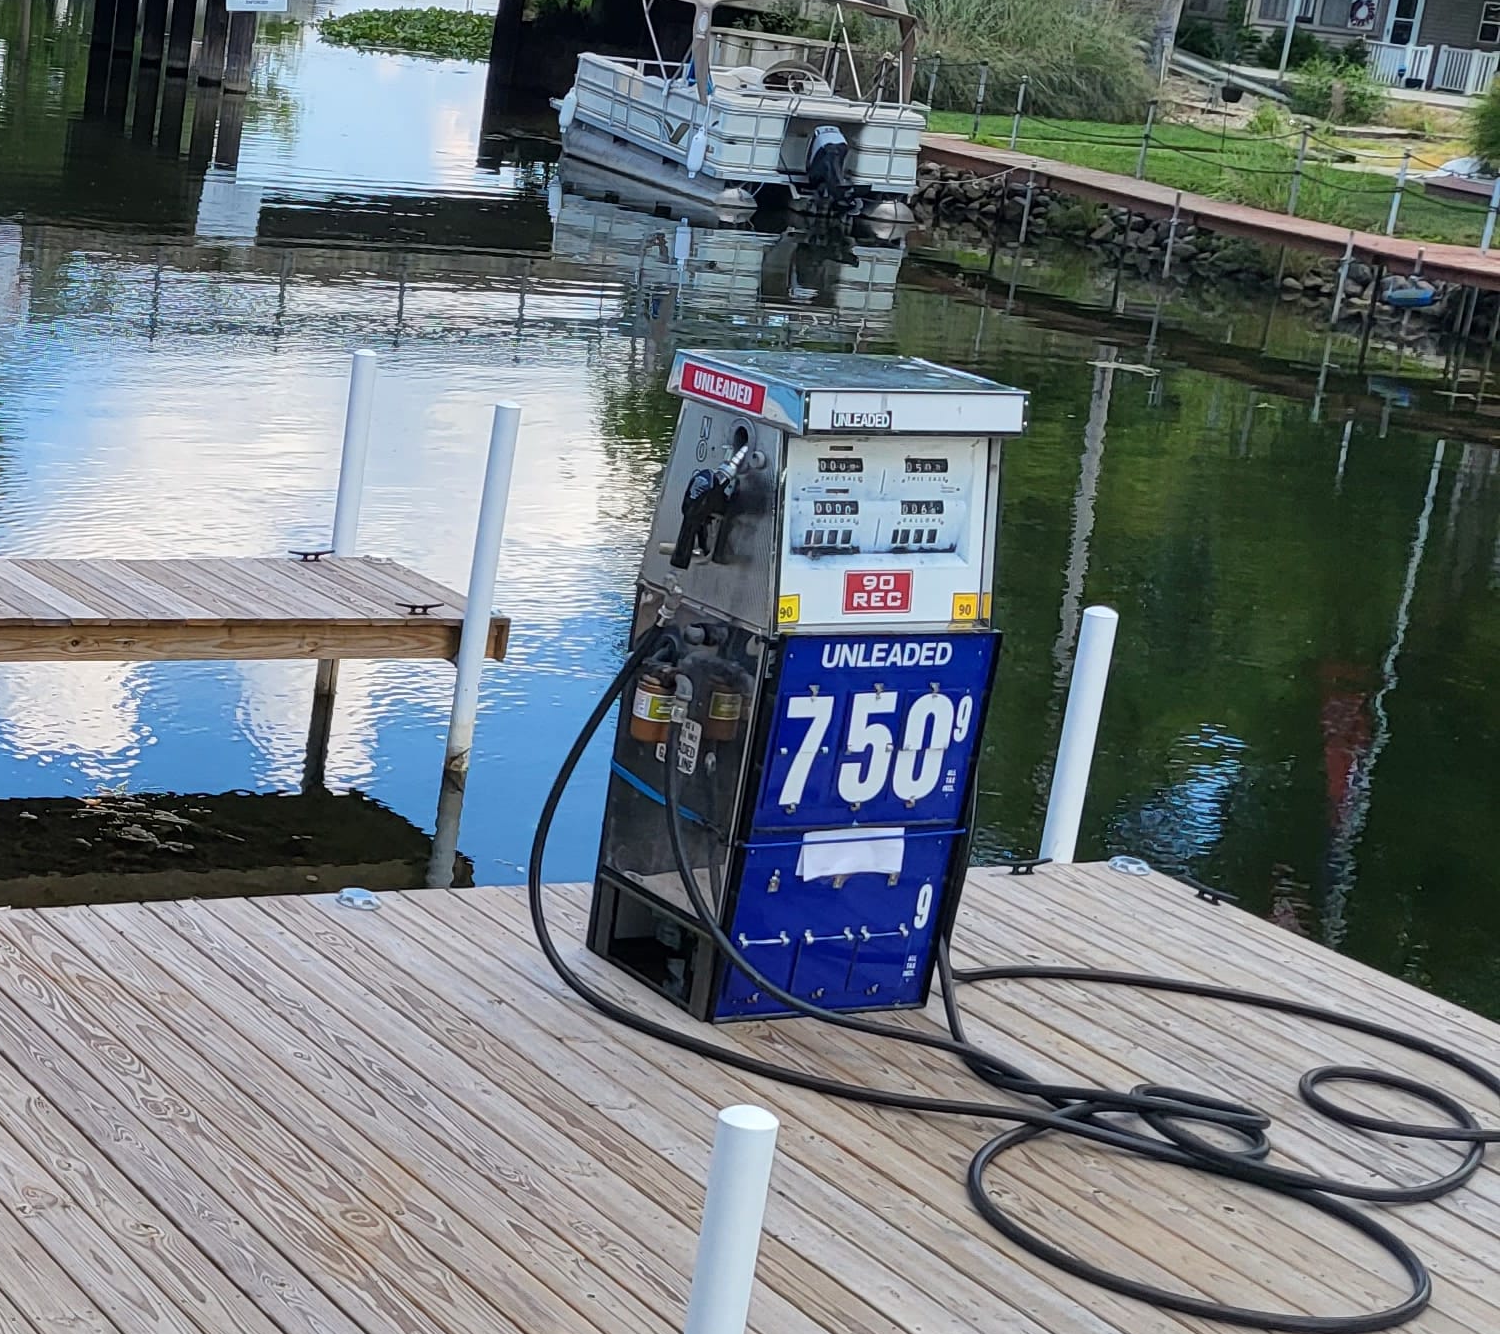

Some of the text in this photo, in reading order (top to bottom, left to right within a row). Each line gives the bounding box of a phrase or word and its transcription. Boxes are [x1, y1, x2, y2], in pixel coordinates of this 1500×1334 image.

[693, 370, 753, 406] UNLEADED
[833, 412, 890, 428] UNLEADED
[863, 575, 895, 590] 90
[853, 592, 901, 607] REC
[779, 606, 793, 619] 90
[958, 604, 972, 616] 90
[821, 642, 953, 668] UNLEADED
[913, 883, 933, 929] 9
